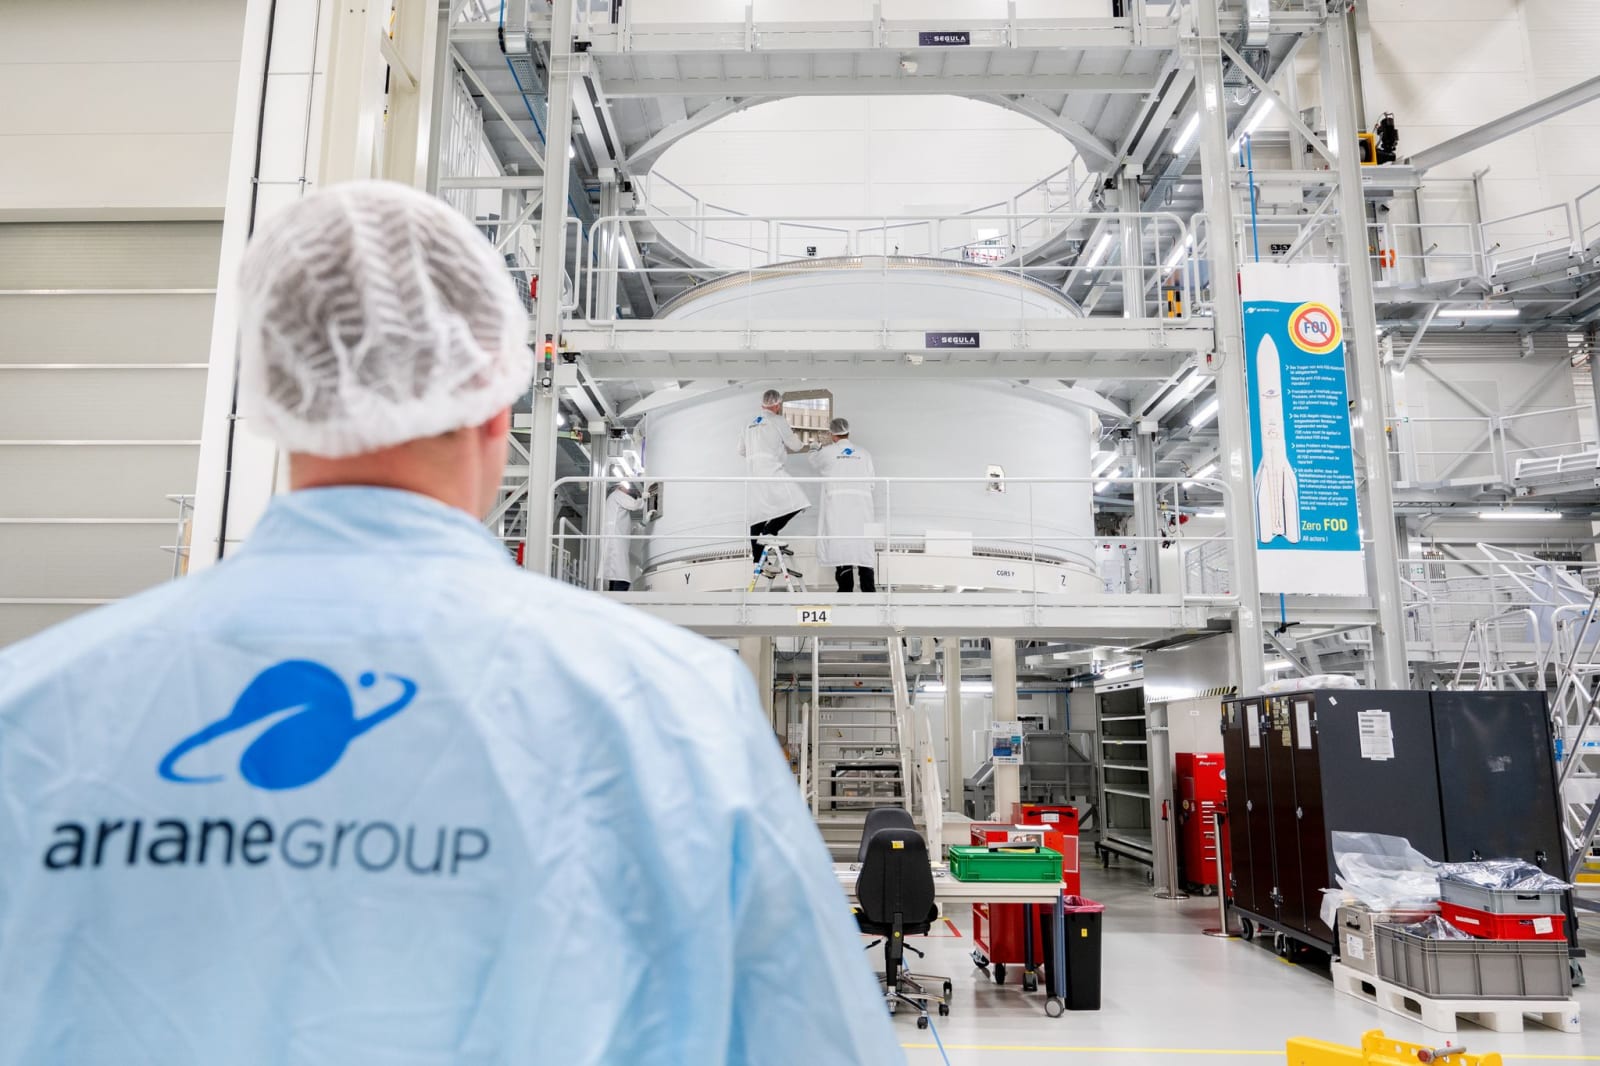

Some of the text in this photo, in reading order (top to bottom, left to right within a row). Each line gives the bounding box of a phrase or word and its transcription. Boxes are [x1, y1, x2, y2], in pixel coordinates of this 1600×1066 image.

[1303, 321, 1328, 334] FOD
[941, 336, 976, 344] SEGULA
[1301, 518, 1348, 532] Zero FOD
[684, 573, 691, 585] Y
[802, 611, 827, 623] P14
